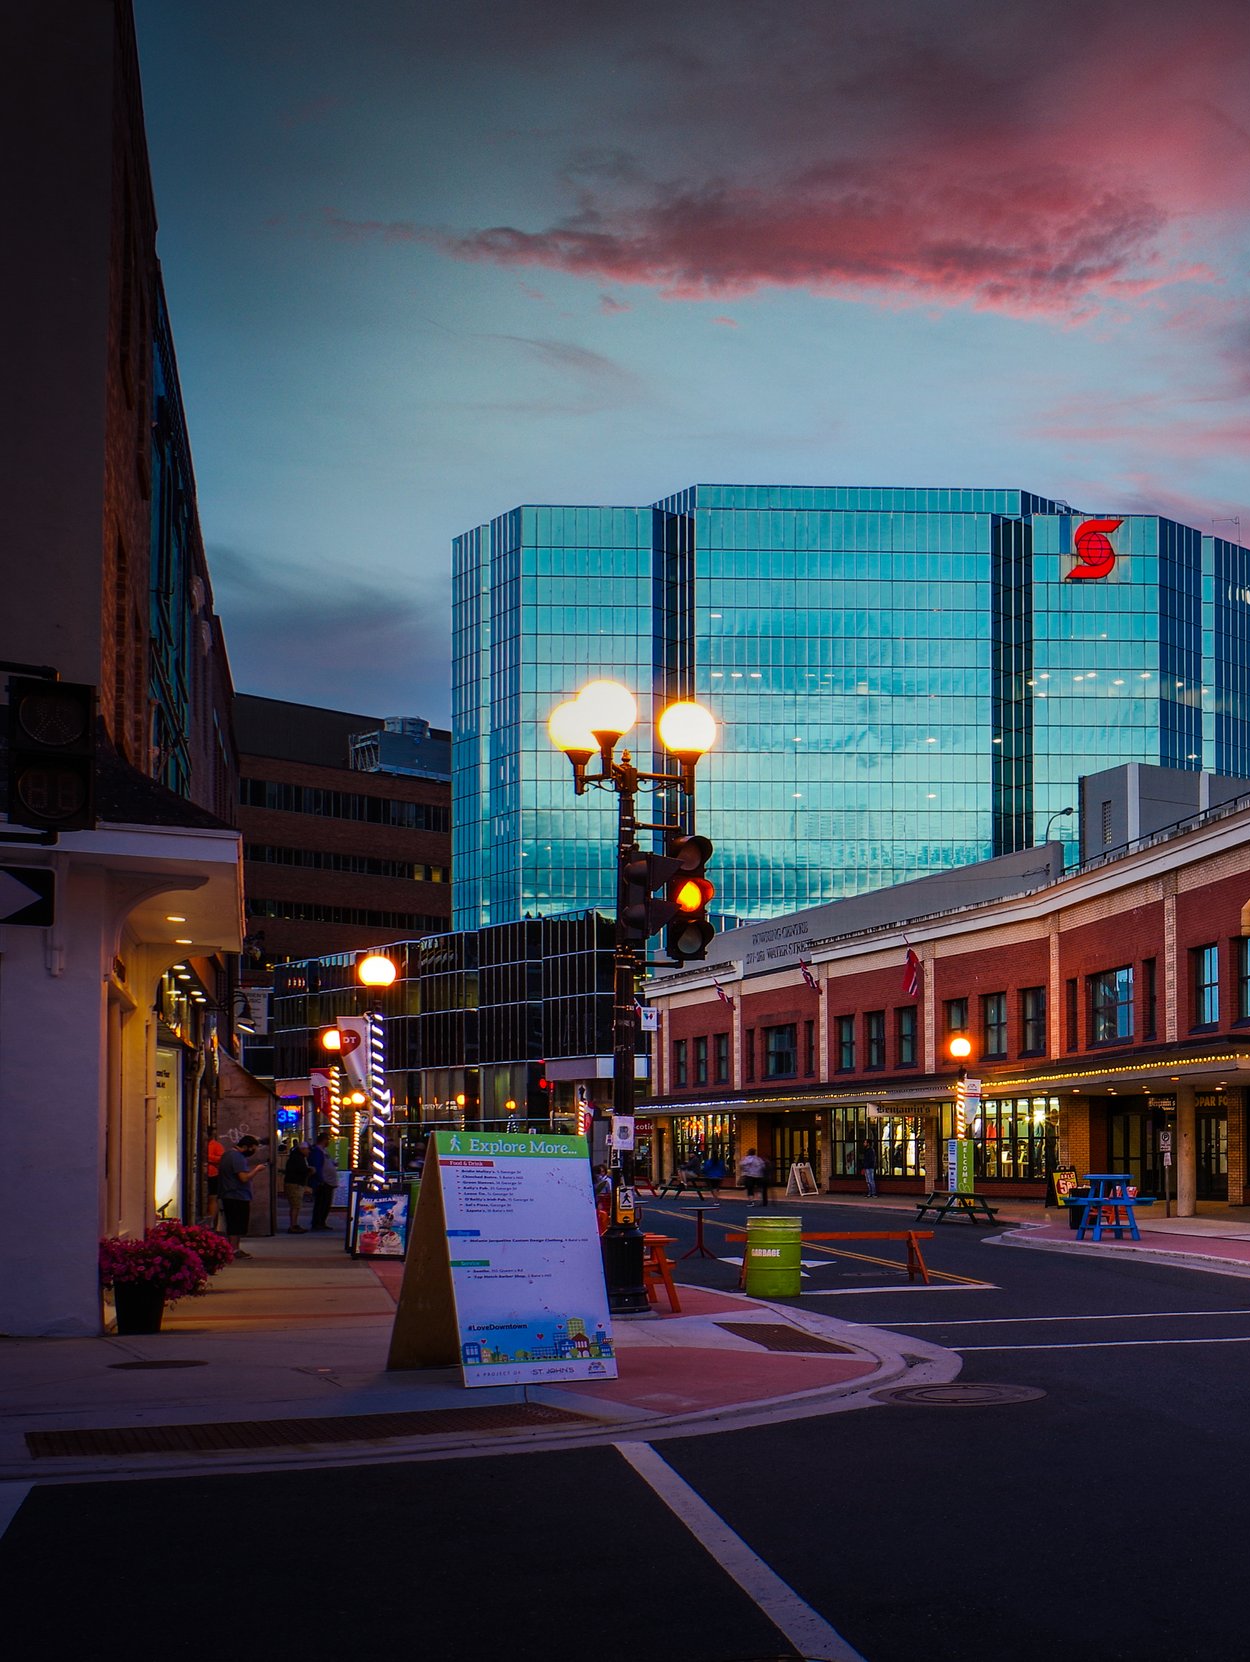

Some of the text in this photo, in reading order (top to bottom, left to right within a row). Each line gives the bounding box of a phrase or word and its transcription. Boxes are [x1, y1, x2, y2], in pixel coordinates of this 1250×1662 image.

[342, 1036, 357, 1044] DT
[876, 1104, 931, 1114] Benjamin's
[470, 1138, 577, 1154] Explore More...
[751, 1248, 780, 1258] GARBAGE
